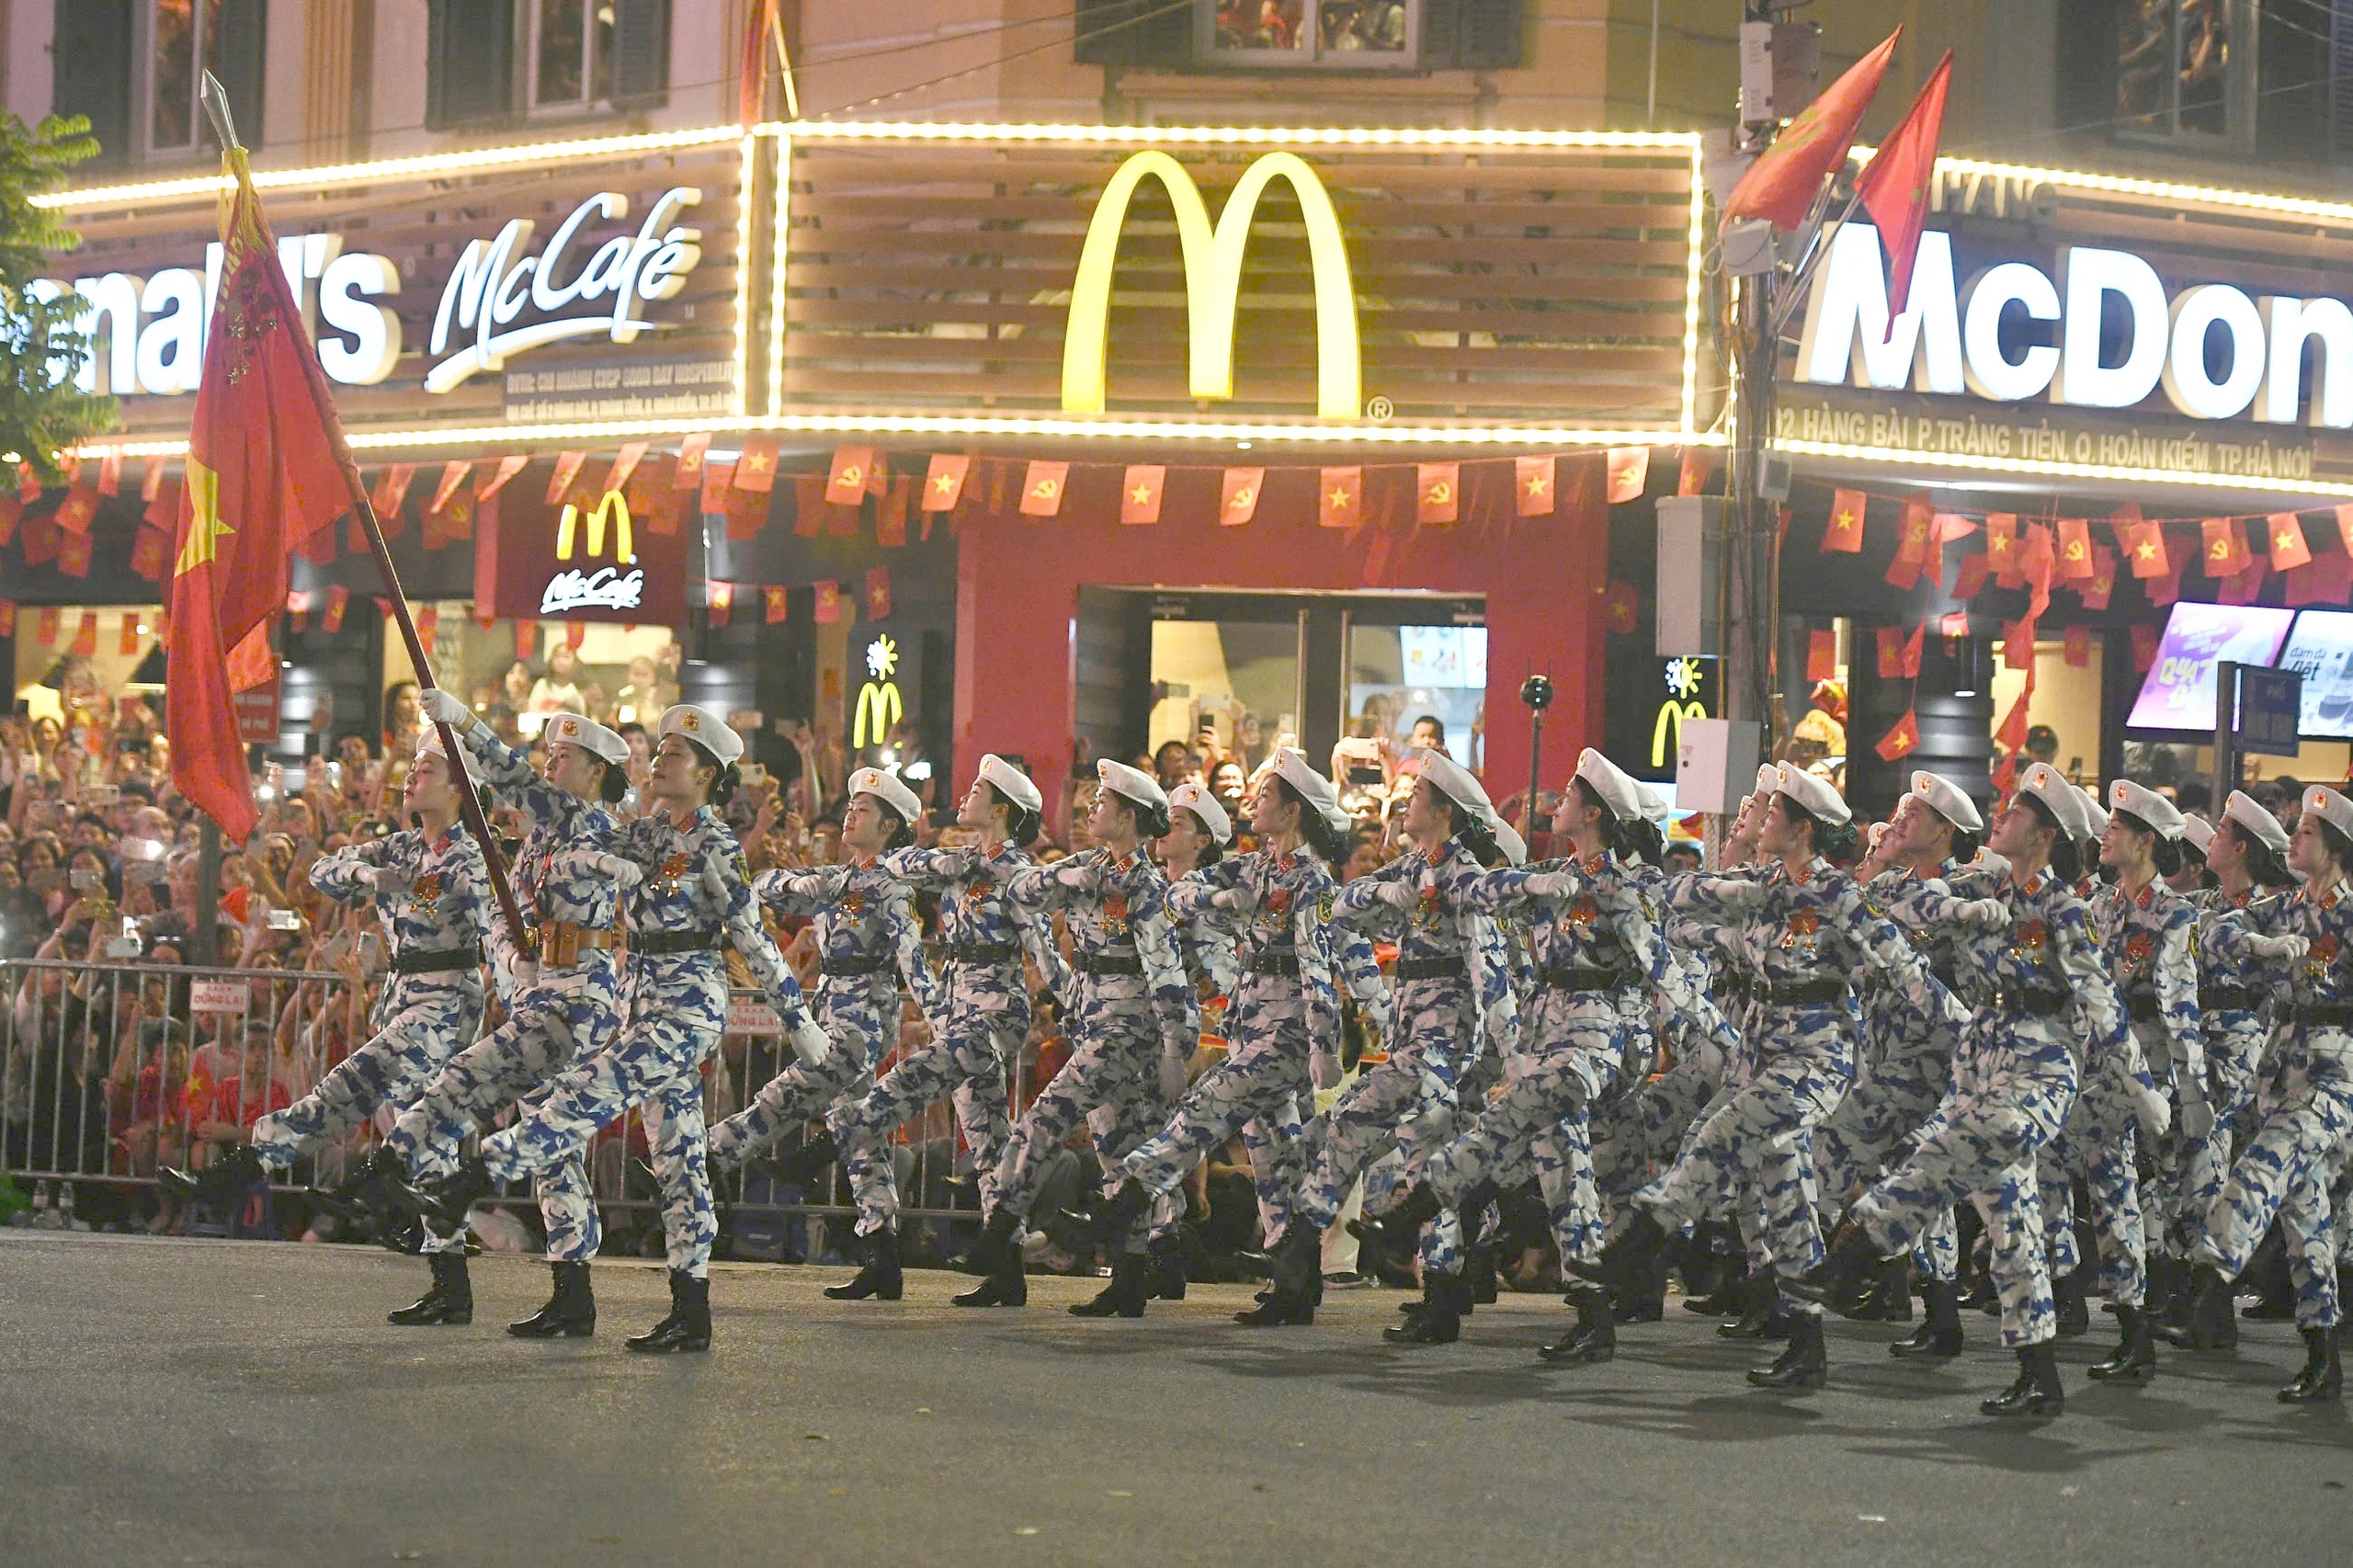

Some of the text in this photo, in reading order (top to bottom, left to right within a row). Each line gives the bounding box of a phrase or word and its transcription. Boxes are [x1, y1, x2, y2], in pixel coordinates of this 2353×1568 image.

[428, 186, 702, 371] McCafé
[1802, 401, 1866, 444] HÀNG
[1872, 406, 1909, 449] BÀI
[540, 566, 644, 614] McCafé
